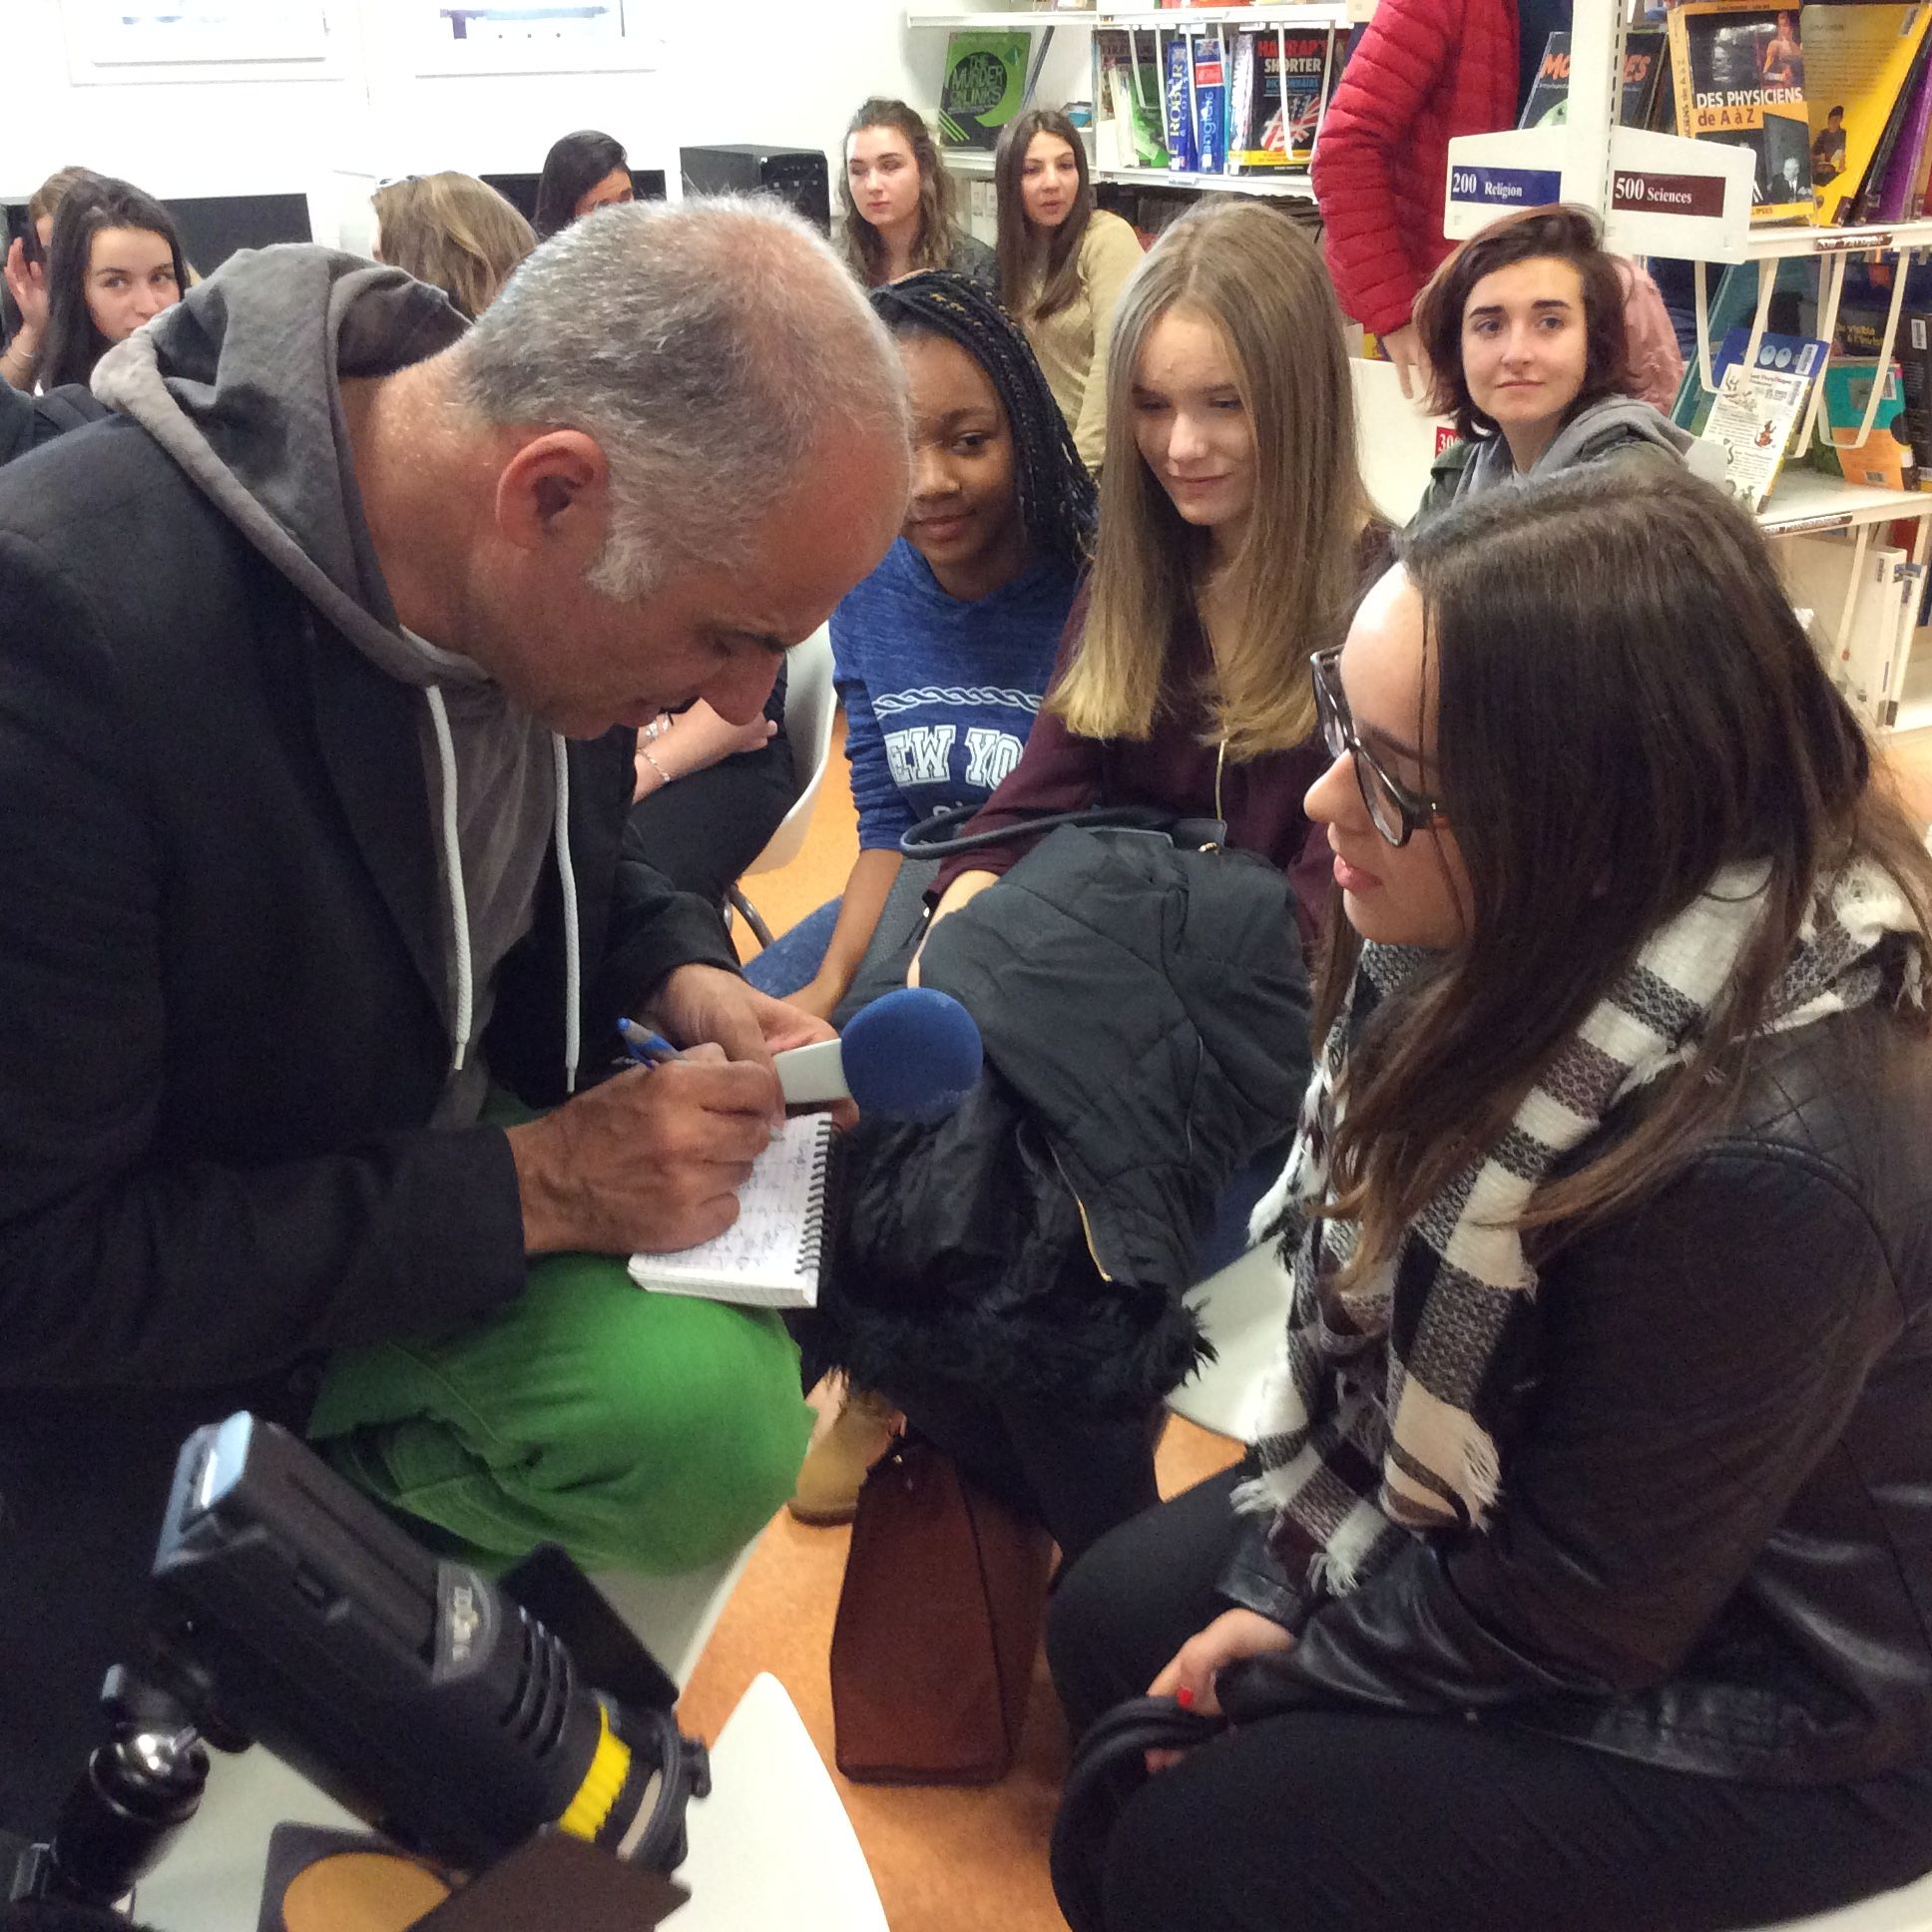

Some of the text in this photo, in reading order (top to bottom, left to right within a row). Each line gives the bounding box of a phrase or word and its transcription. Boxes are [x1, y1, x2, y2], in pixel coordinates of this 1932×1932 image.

[1696, 87, 1803, 109] DES PHYSICIENS
[1697, 107, 1754, 126] de A à Z
[1452, 172, 1523, 199] 200 Religion
[1615, 178, 1692, 205] 500 Sciences
[884, 724, 1025, 790] EW YO
